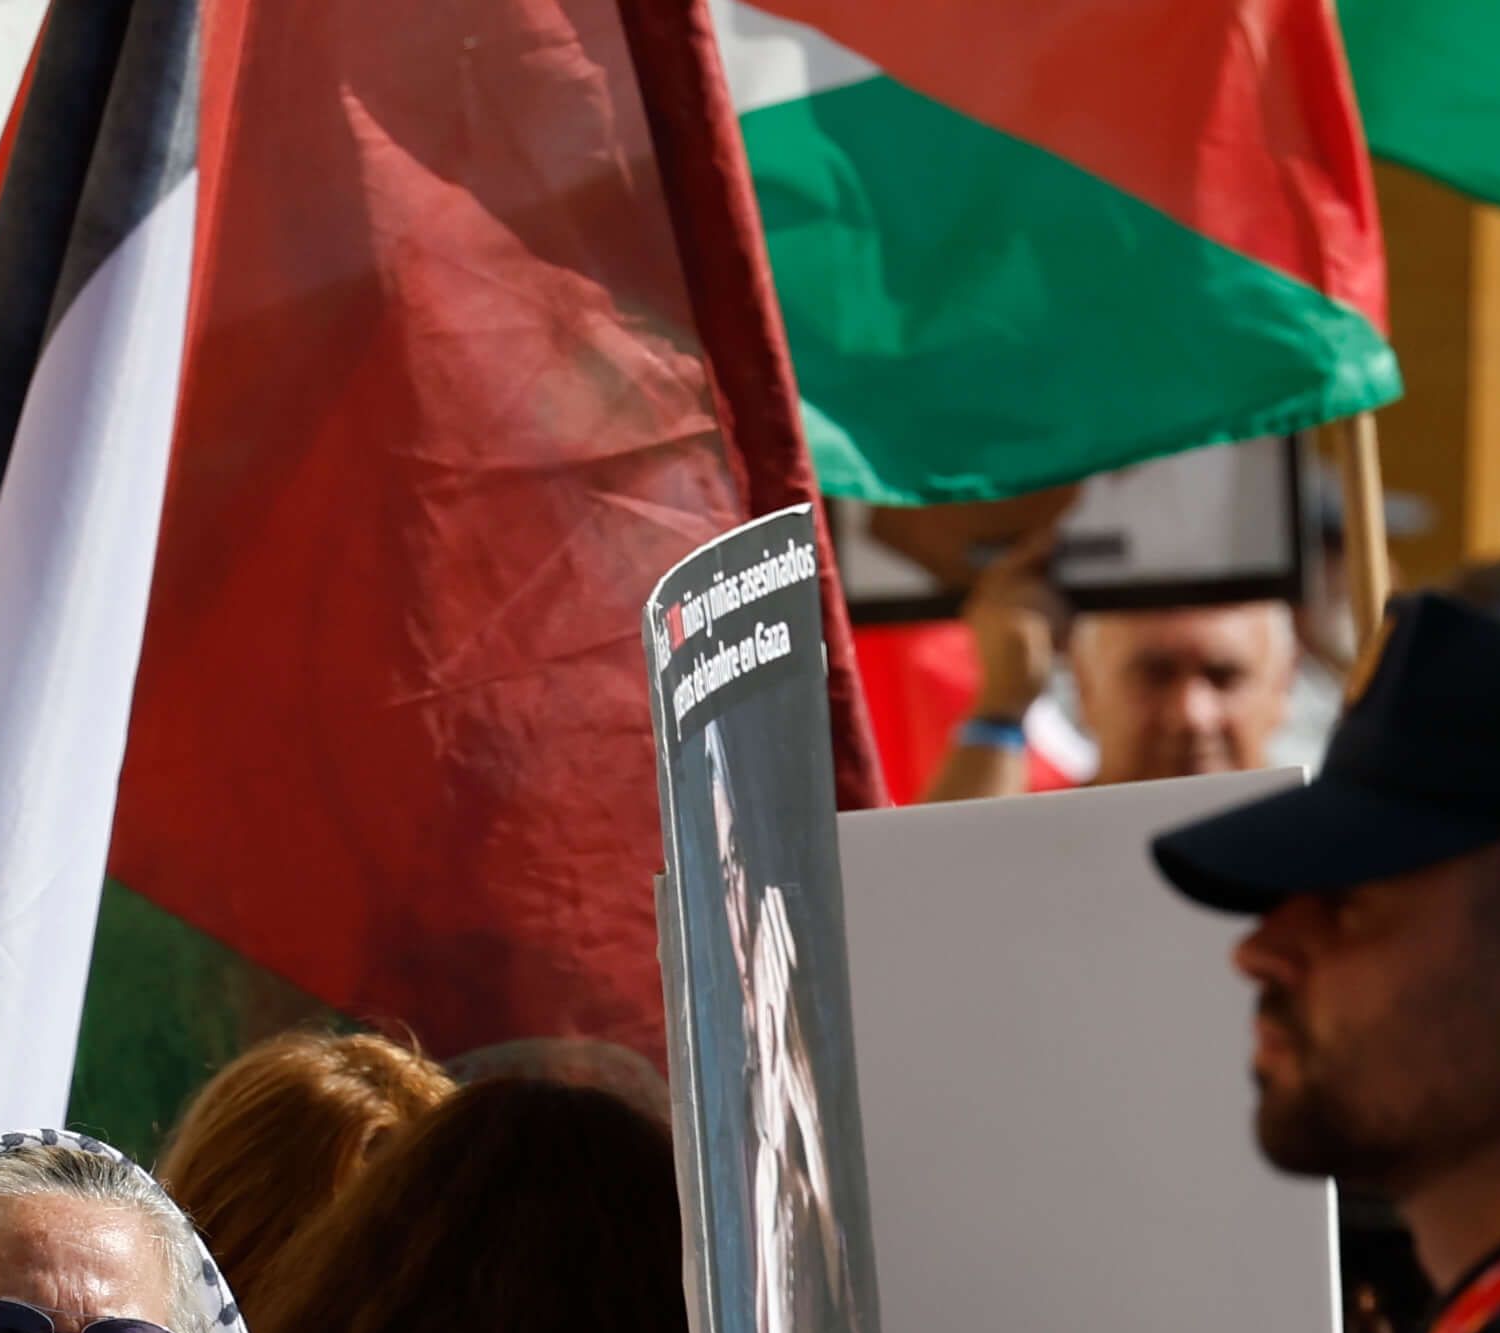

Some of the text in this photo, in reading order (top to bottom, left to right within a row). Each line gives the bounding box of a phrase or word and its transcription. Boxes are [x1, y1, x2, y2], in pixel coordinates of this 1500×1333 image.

[739, 538, 816, 604] asesinados
[739, 636, 757, 673] en
[754, 621, 792, 664] Gaza
